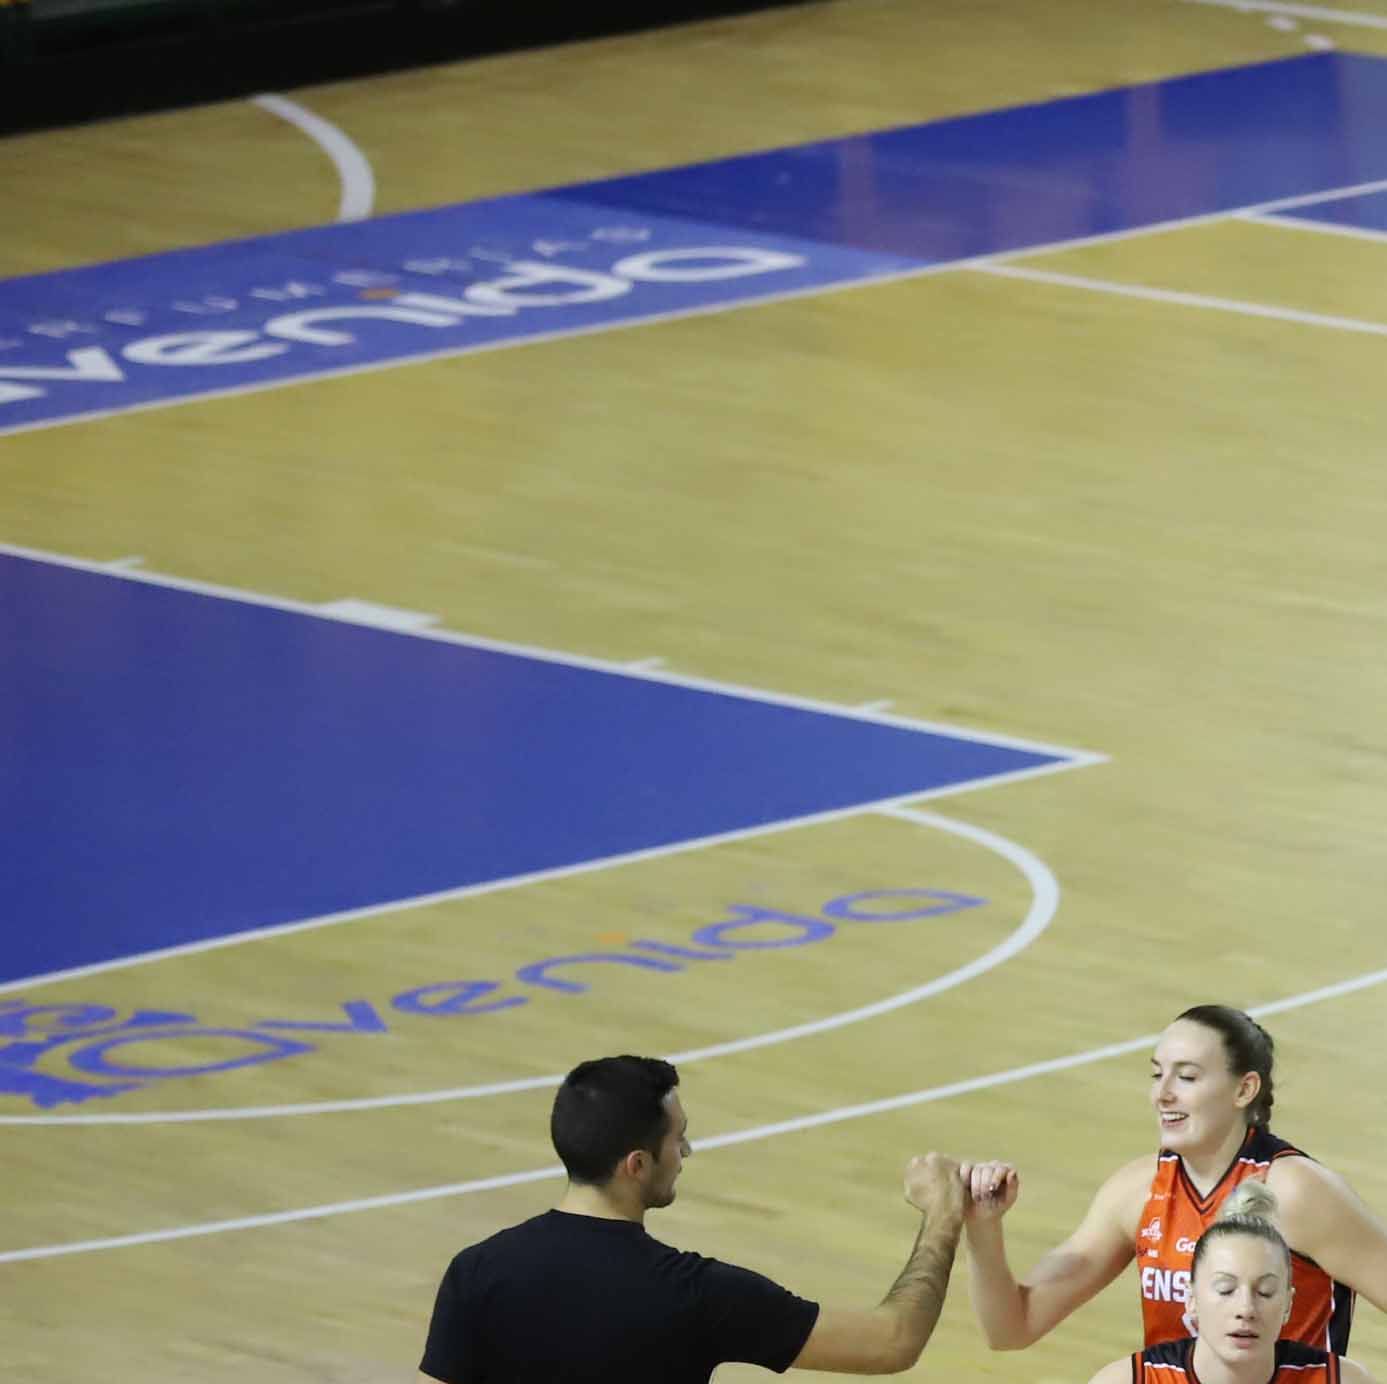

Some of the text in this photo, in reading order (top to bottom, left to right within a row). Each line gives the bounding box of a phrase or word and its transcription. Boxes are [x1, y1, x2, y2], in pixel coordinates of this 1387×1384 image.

[0, 246, 803, 402] venida
[68, 888, 988, 1078] avenida
[1142, 1267, 1192, 1303] ENS
